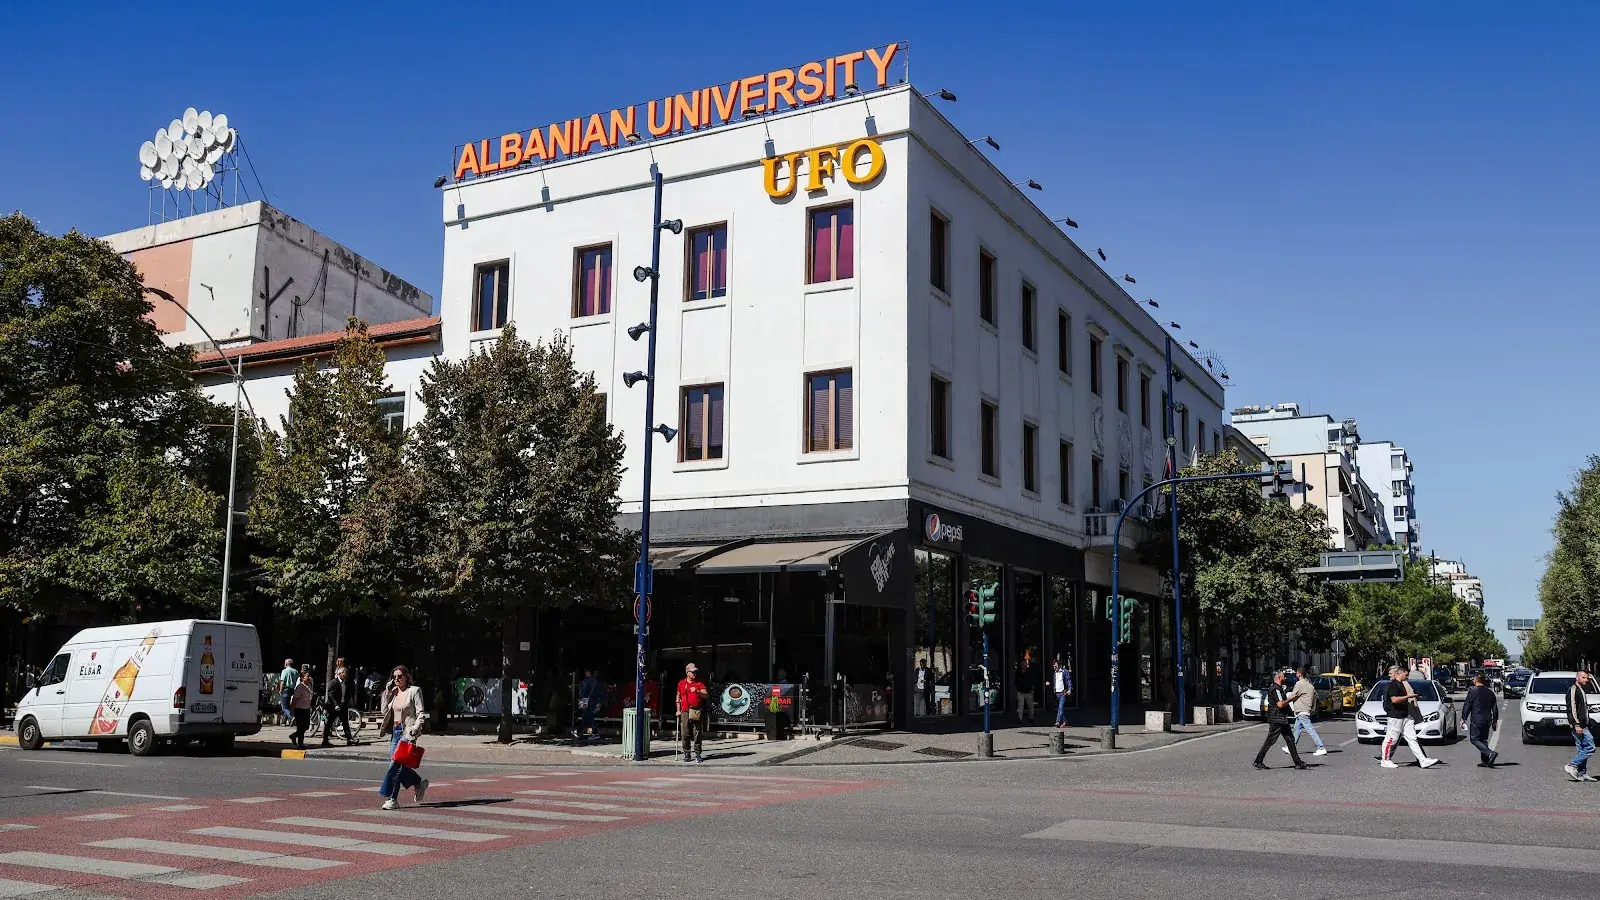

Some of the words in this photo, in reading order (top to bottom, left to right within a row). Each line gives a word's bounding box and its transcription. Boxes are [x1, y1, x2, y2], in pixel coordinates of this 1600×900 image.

[455, 105, 635, 179] ALBANIAN
[647, 43, 899, 136] UNIVERSITY
[760, 138, 887, 198] UFO
[941, 523, 963, 542] pepsi
[79, 664, 102, 676] ELBAR
[231, 661, 253, 670] ELBAR
[104, 694, 121, 717] ELBAR
